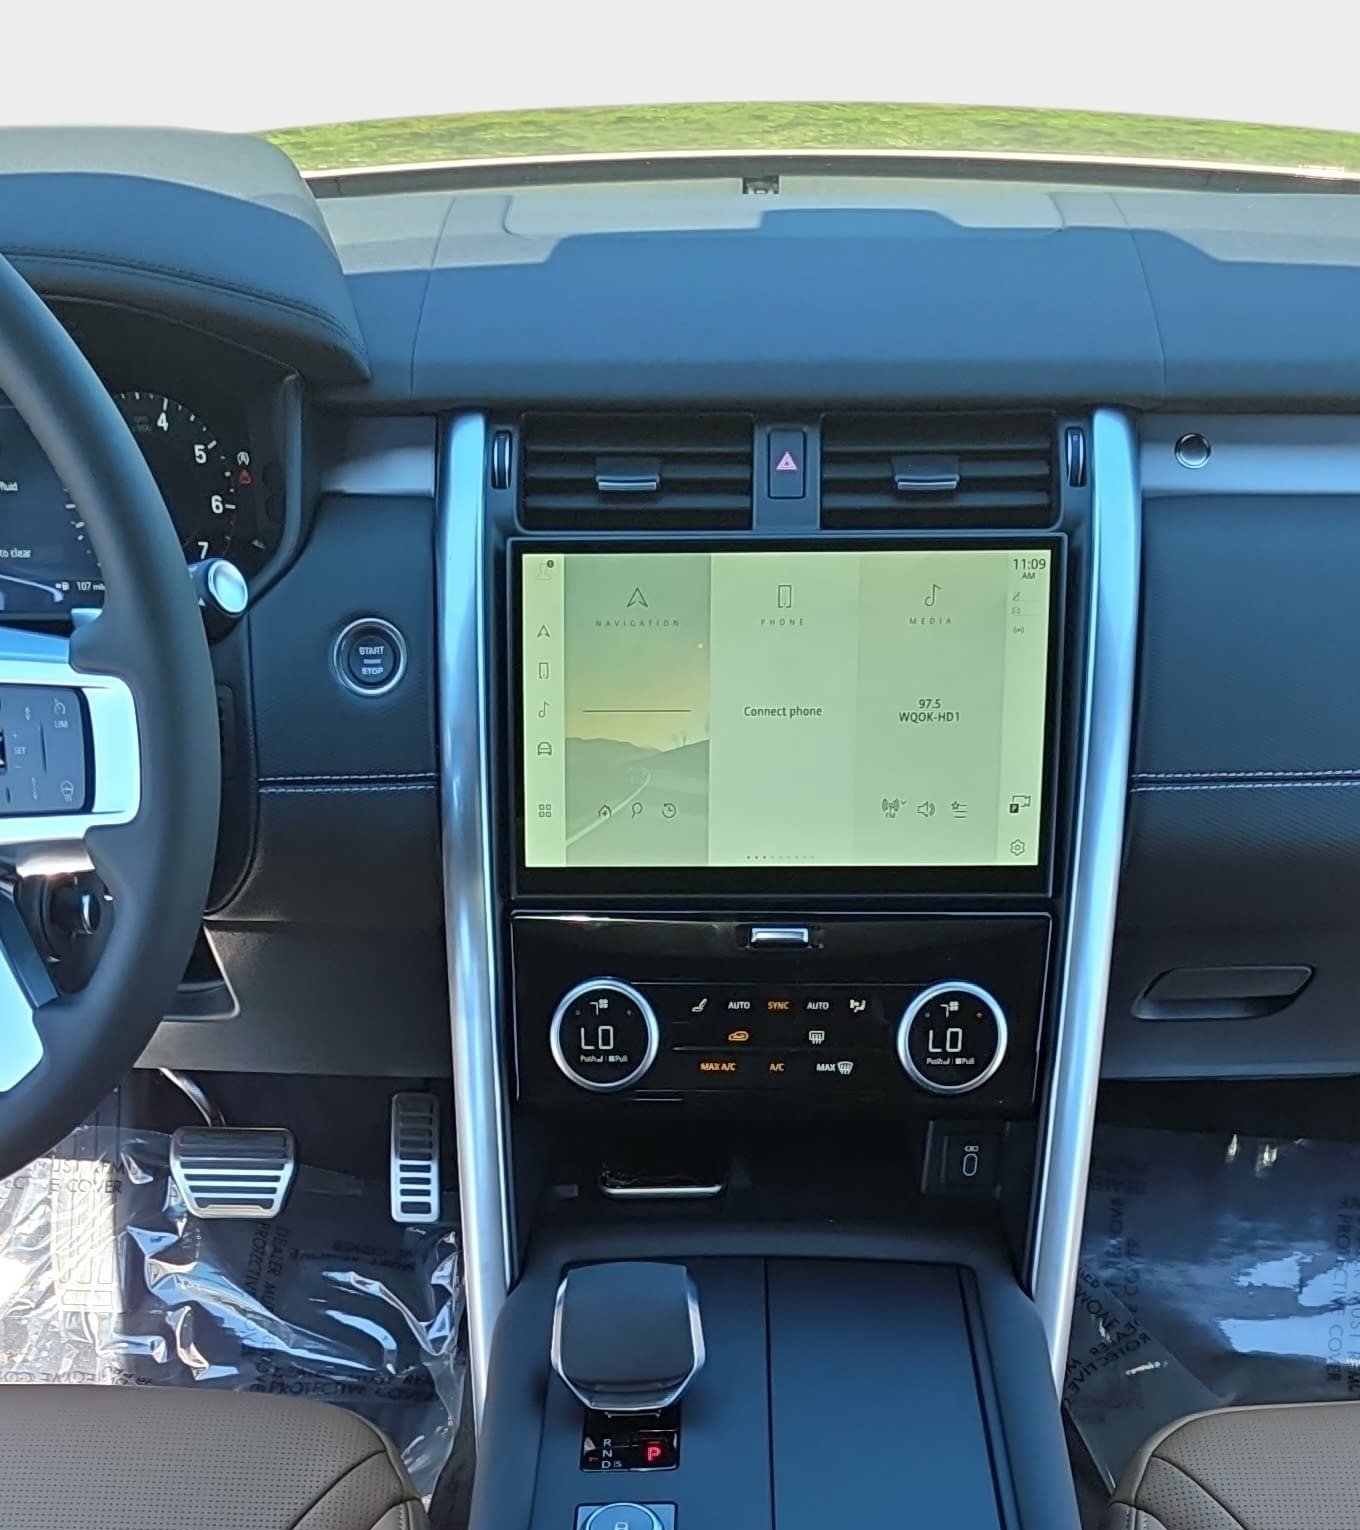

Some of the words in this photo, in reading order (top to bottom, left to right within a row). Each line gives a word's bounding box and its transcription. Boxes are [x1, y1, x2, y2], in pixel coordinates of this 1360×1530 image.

[156, 412, 169, 431] 4
[194, 444, 207, 464] 5
[0, 481, 18, 491] fluid
[211, 495, 224, 514] 6
[0, 548, 9, 558] to
[10, 547, 31, 558] clear
[198, 541, 209, 559] 7
[1013, 558, 1046, 570] 11:09
[1022, 572, 1036, 580] AM
[76, 581, 91, 590] 107
[595, 619, 680, 627] NAVIGATION
[761, 618, 805, 626] PHONE
[909, 617, 952, 625] MEDIA
[359, 646, 384, 655] START
[362, 667, 384, 675] STOP
[918, 699, 941, 709] 97.5
[744, 706, 786, 717] Connect
[789, 706, 823, 718] phone
[899, 712, 960, 723] WQOK-HD1
[728, 1001, 751, 1010] AUTO
[767, 1001, 789, 1010] SYNC
[807, 1002, 829, 1010] AUTO
[580, 1025, 614, 1050] LO
[928, 1027, 963, 1053] LO
[700, 1063, 719, 1071] MAX
[720, 1062, 736, 1071] A/C
[770, 1063, 784, 1072] A/C
[816, 1063, 835, 1072] MAX
[603, 1438, 612, 1447] R
[602, 1449, 612, 1457] N
[647, 1446, 661, 1461] P
[601, 1460, 612, 1468] D
